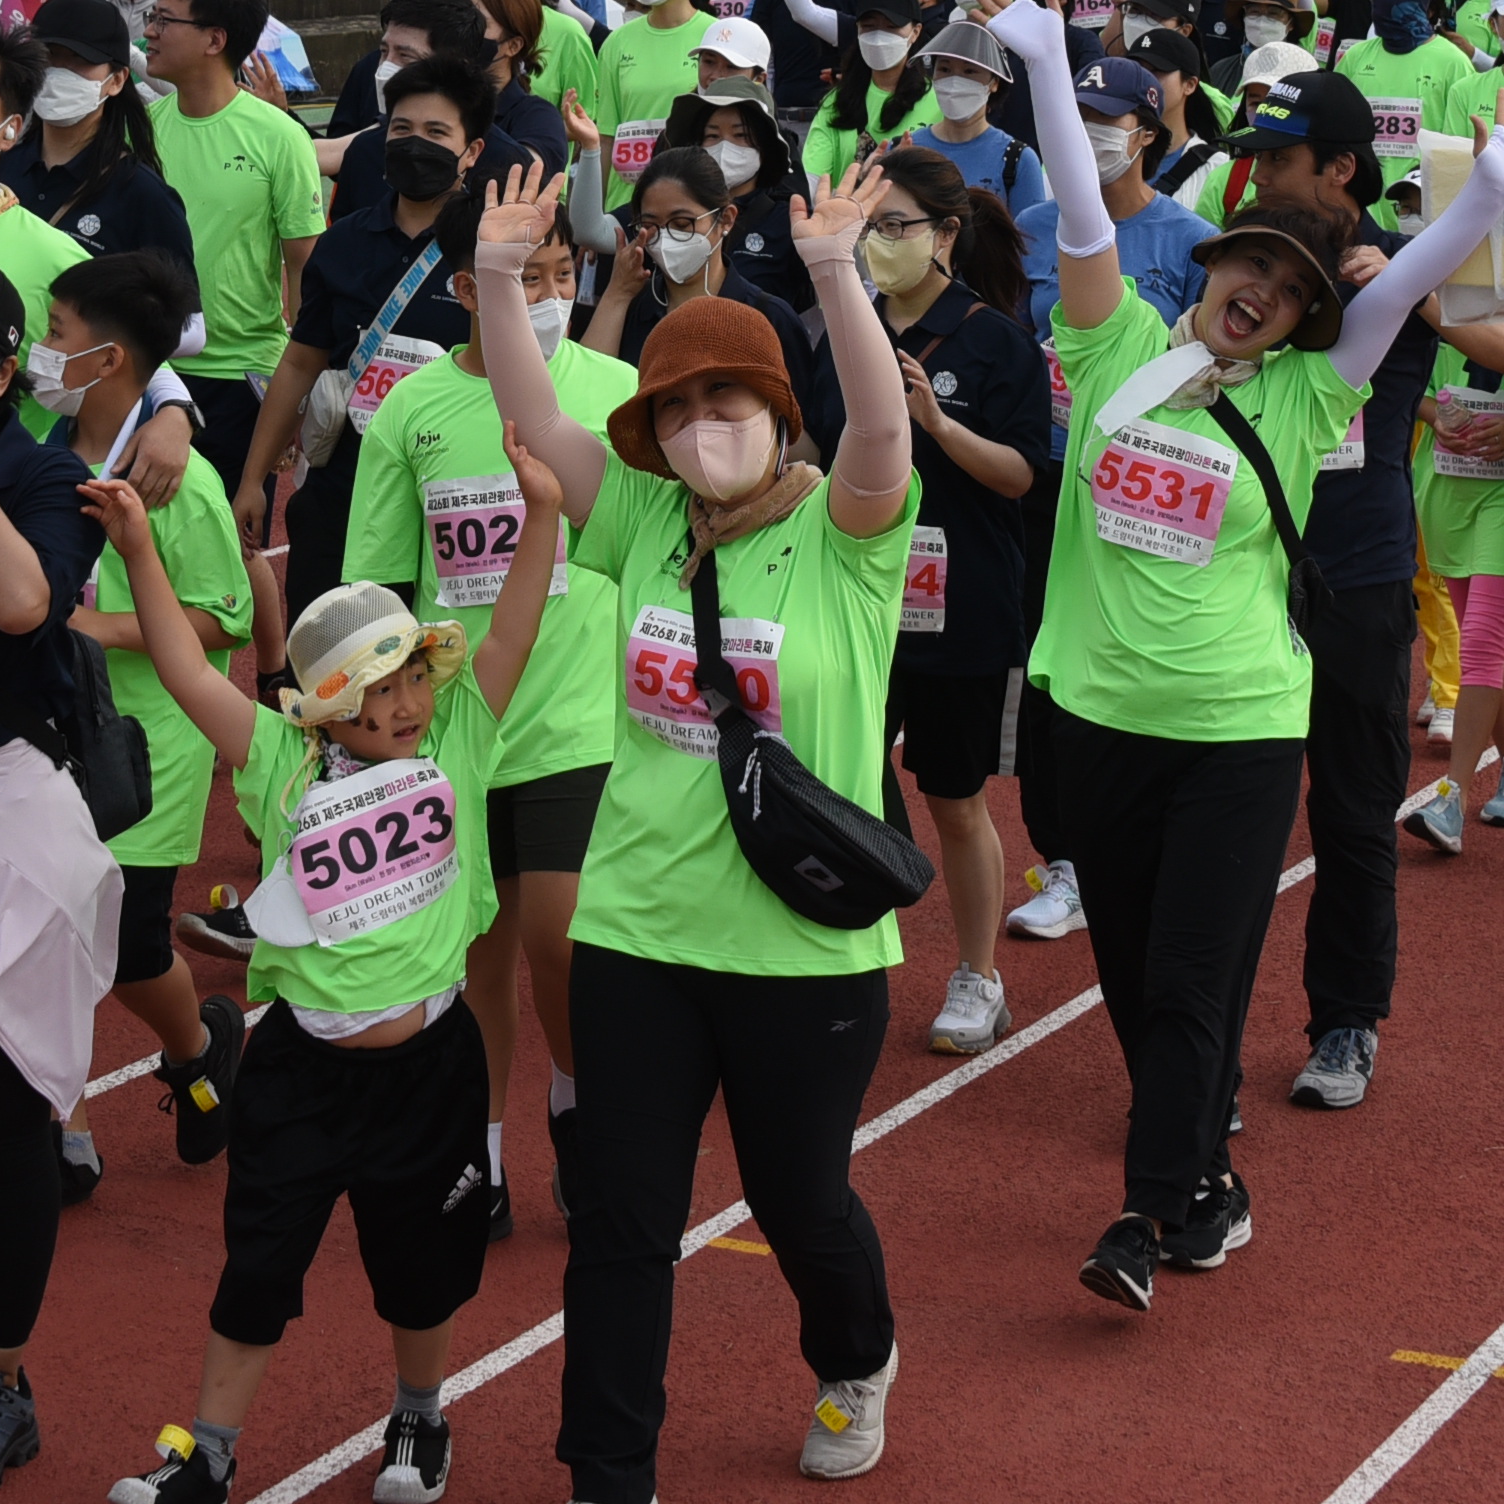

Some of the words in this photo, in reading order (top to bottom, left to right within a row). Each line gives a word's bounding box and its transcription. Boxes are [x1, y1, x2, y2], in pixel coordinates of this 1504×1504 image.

[1078, 66, 1107, 89] A
[1375, 115, 1417, 136] 283
[400, 262, 426, 299] NIKE
[377, 293, 404, 333] NIKE
[357, 328, 383, 364] NIKE
[352, 410, 369, 422] JEJU
[416, 431, 441, 449] Jeju
[1133, 435, 1231, 476] 제주국제관광마라톤축제
[451, 489, 523, 508] 제주국제관광마라
[1096, 450, 1215, 521] 5531
[434, 515, 519, 560] 502
[1115, 517, 1157, 536] DREAM
[1161, 529, 1201, 550] TOWER
[669, 548, 688, 568] Jej
[446, 579, 463, 591] JEJU
[903, 610, 934, 619] OWER
[639, 622, 677, 642] 제26회
[634, 649, 770, 712] 550
[642, 716, 667, 732] JEJU
[671, 724, 718, 741] DREAM
[298, 813, 321, 834] 26회
[324, 768, 440, 822] 제주국제관광마라톤축제
[300, 796, 453, 890] 5023
[327, 905, 360, 926] JEJU
[364, 882, 414, 909] DREAM
[418, 857, 454, 888] TOWER
[348, 916, 367, 931] 제주
[371, 902, 407, 922] 드림타워
[408, 881, 445, 908] 복합리조트
